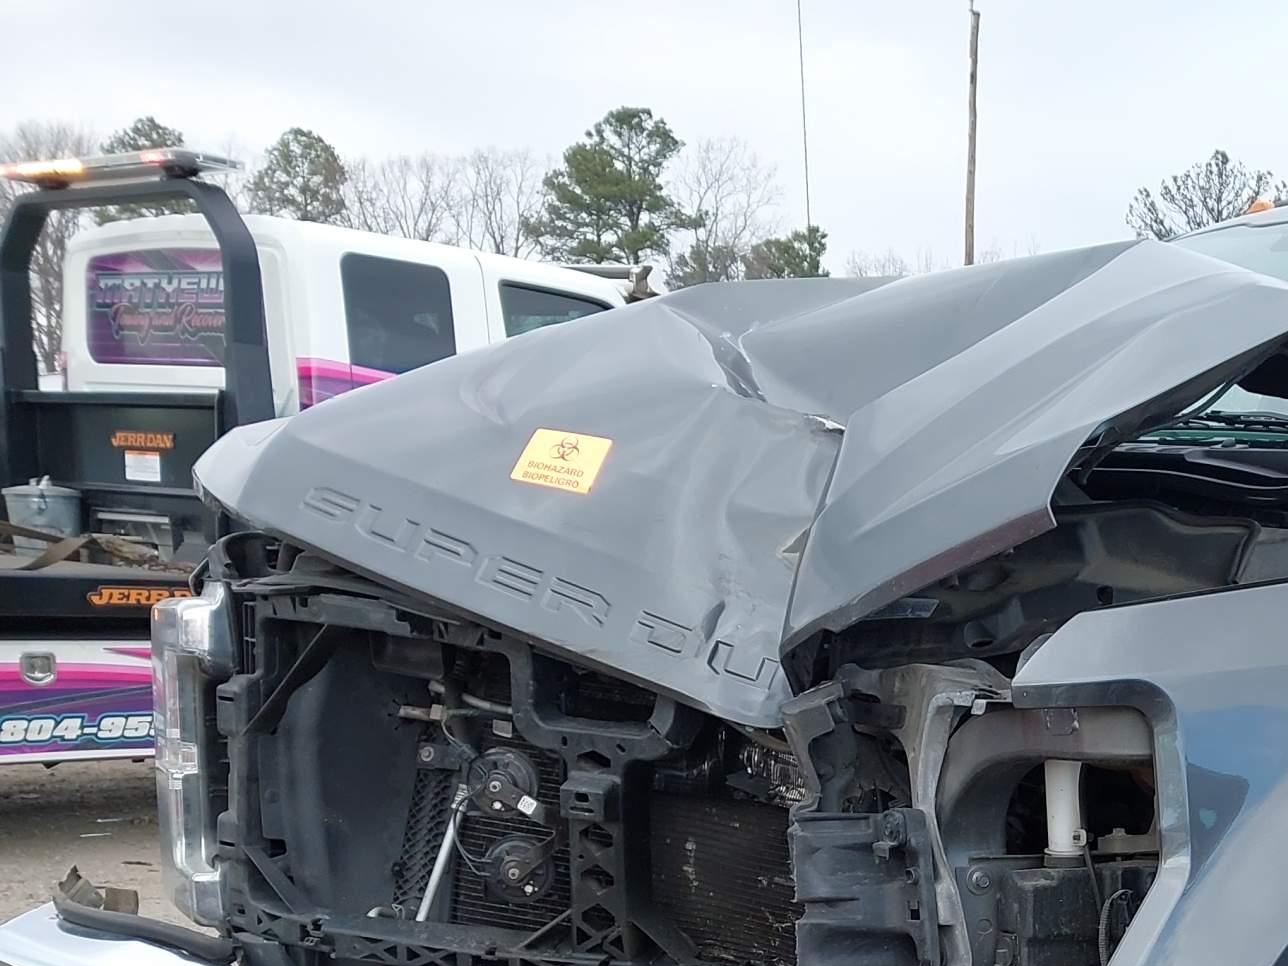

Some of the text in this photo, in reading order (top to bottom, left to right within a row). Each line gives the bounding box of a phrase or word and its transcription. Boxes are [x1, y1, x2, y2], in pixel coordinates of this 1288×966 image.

[521, 470, 580, 489] BIOPELIGRO
[527, 460, 585, 478] BIOHAZARD
[300, 486, 612, 631] SUPER
[0, 714, 155, 743] 804-95
